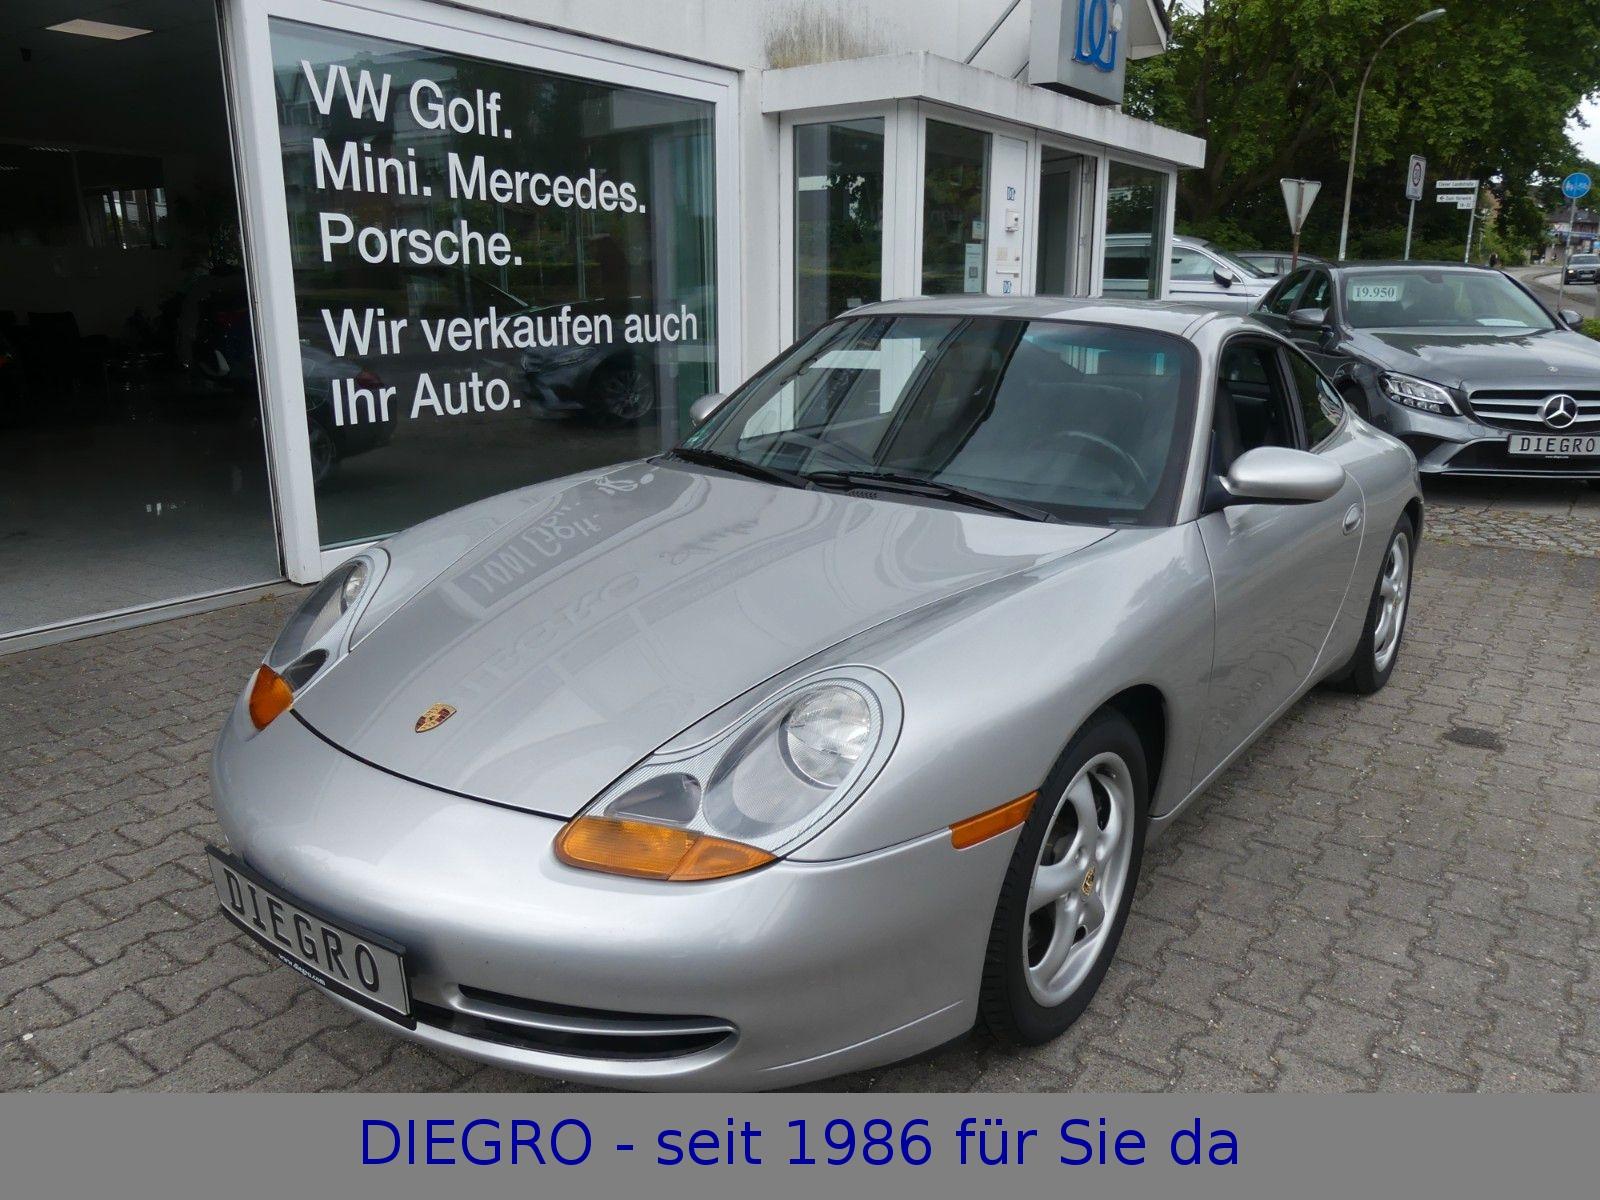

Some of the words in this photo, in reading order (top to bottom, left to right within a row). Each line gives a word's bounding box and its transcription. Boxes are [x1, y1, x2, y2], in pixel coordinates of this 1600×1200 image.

[301, 60, 392, 123] VW
[408, 79, 515, 139] Golf.
[313, 138, 432, 197] Mini.
[449, 153, 646, 214] Mercedes.
[319, 212, 522, 266] Porsche.
[322, 309, 408, 357] Wir
[421, 306, 613, 352] verkaufen
[625, 305, 698, 344] auch
[332, 379, 398, 426] Ihr
[411, 373, 521, 419] Auto.
[1519, 437, 1595, 453] DIEGRO
[224, 868, 379, 993] DIEGRO
